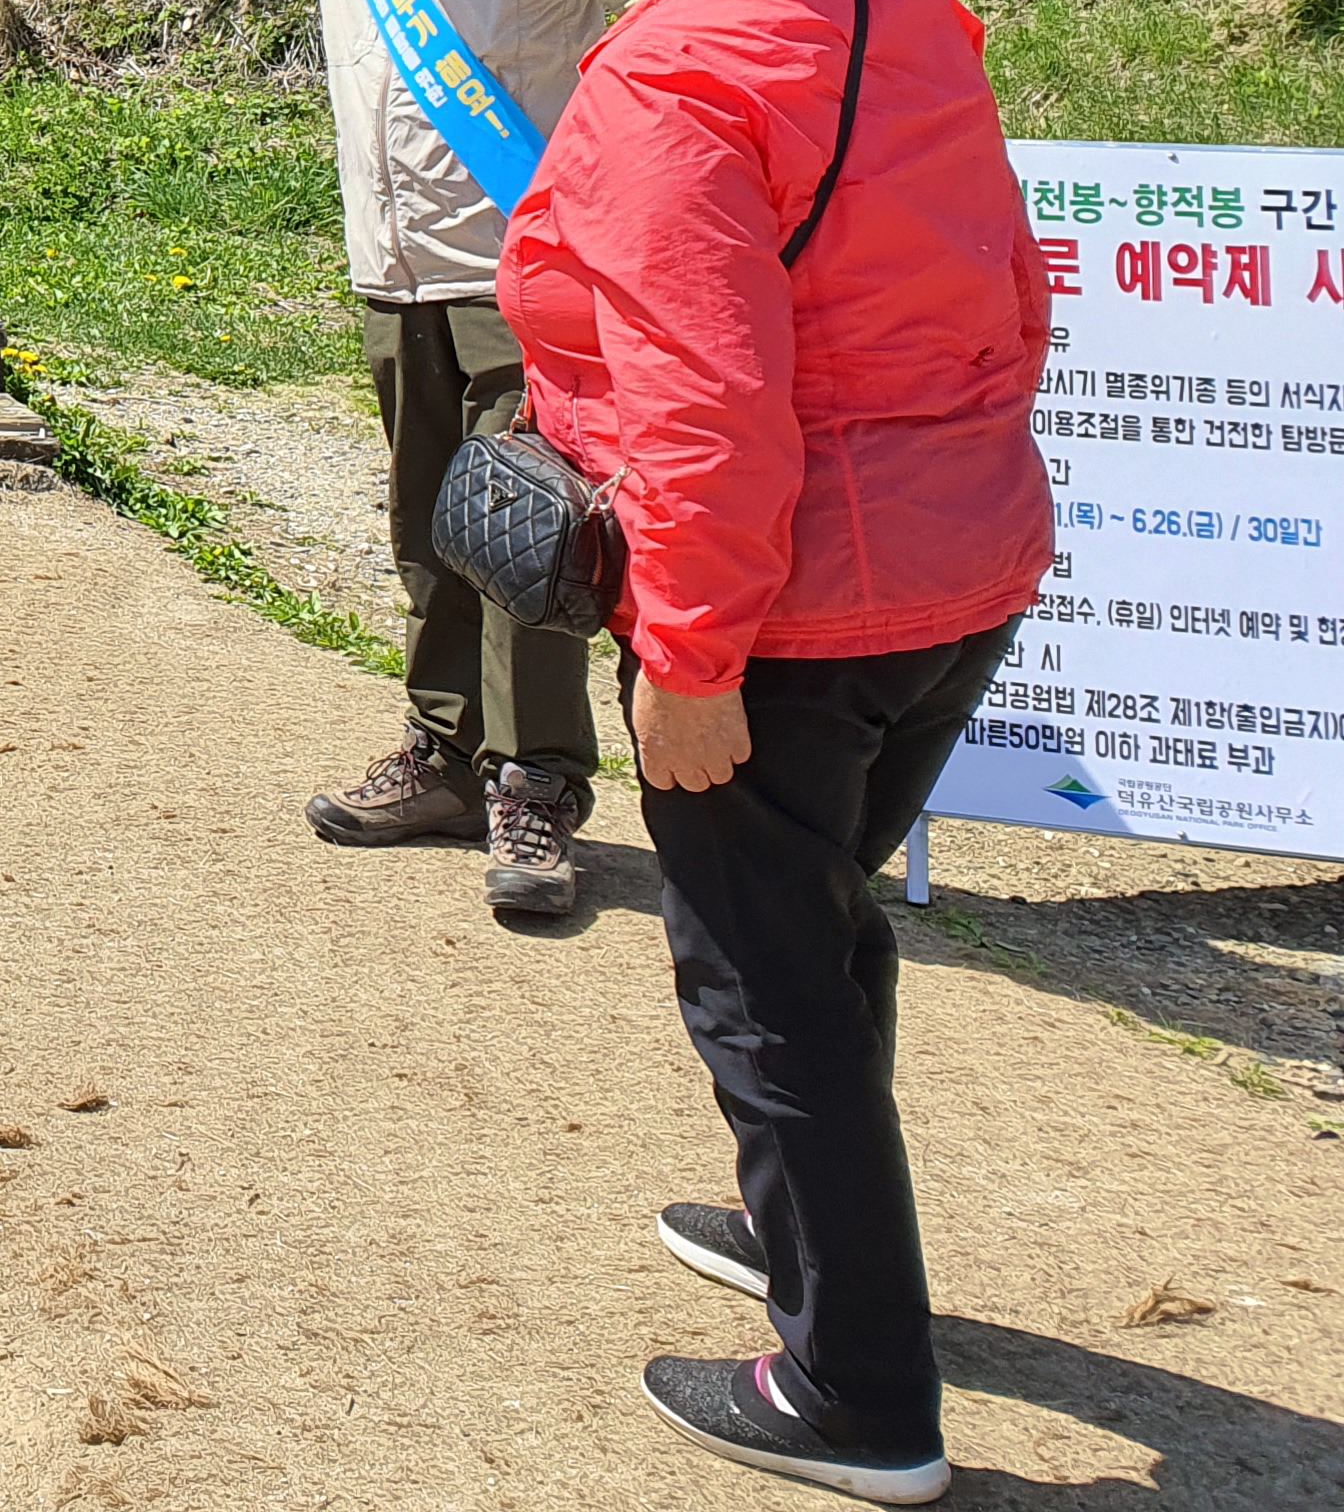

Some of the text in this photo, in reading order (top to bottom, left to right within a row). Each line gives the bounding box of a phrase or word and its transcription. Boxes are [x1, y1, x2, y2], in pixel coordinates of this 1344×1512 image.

[414, 67, 448, 108] 위한
[435, 50, 509, 138] 해요!
[1020, 179, 1337, 231] 천봉~향적봉 구간
[1115, 240, 1272, 307] 예약제
[1049, 327, 1071, 353] 유
[1105, 371, 1217, 405] 멸종위기종
[1225, 378, 1270, 407] 등의
[1032, 409, 1142, 442] 이용조절을
[1150, 415, 1196, 445] 통한
[1203, 419, 1272, 450] 건전한
[1050, 458, 1071, 486] 간
[1132, 508, 1223, 539] 6.26.(금)
[1230, 515, 1241, 542] /
[1247, 516, 1323, 547] 30일간
[1052, 551, 1072, 579] 법
[1107, 599, 1162, 631] (휴일)
[1170, 604, 1232, 637] 인터넷
[1238, 609, 1282, 640] 예약
[1288, 613, 1309, 643] 및
[1041, 644, 1061, 672] 시
[1084, 688, 1161, 724] 제28조
[1170, 696, 1344, 742] 제1항(출입금지)
[1095, 730, 1140, 762] 이하
[1148, 735, 1218, 769] 과태료
[1227, 742, 1275, 776] 부과
[1118, 778, 1172, 792] 국립공원공단
[1117, 789, 1314, 826] 덕유산국립공원사무소
[1118, 808, 1278, 832] DEOGYUSAN NATIONAL PARK OFFICE
